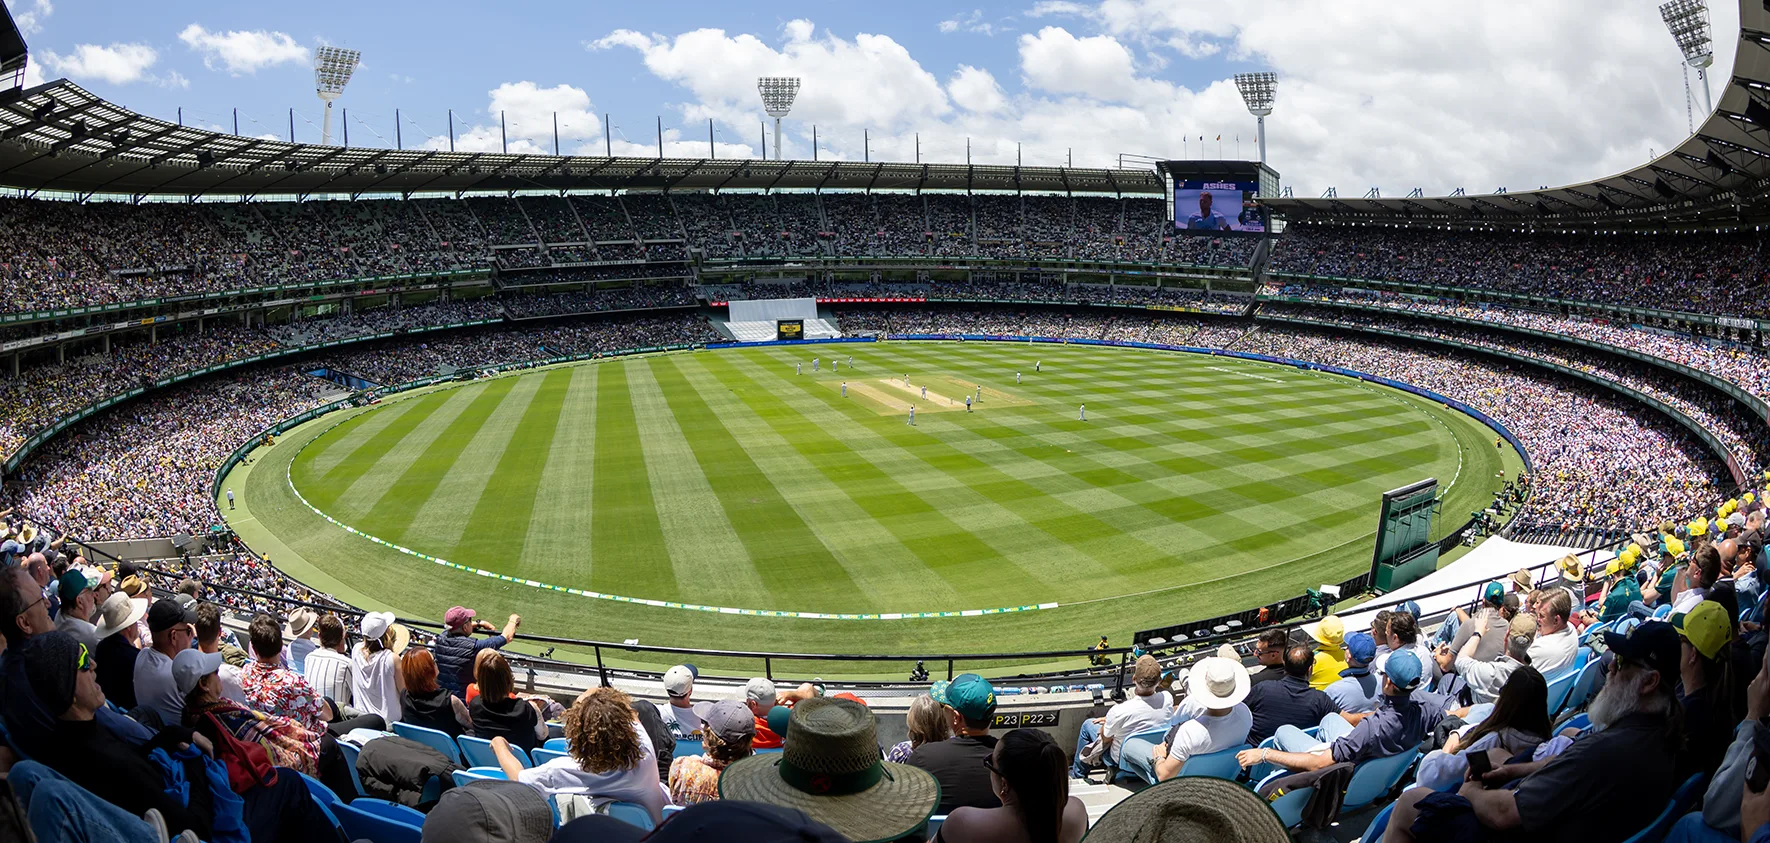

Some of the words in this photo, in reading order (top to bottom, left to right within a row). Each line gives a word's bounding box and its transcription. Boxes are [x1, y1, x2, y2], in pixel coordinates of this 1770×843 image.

[1697, 70, 1703, 80] 3
[327, 101, 333, 109] 6
[995, 715, 1018, 726] P23
[1022, 713, 1044, 725] P22
